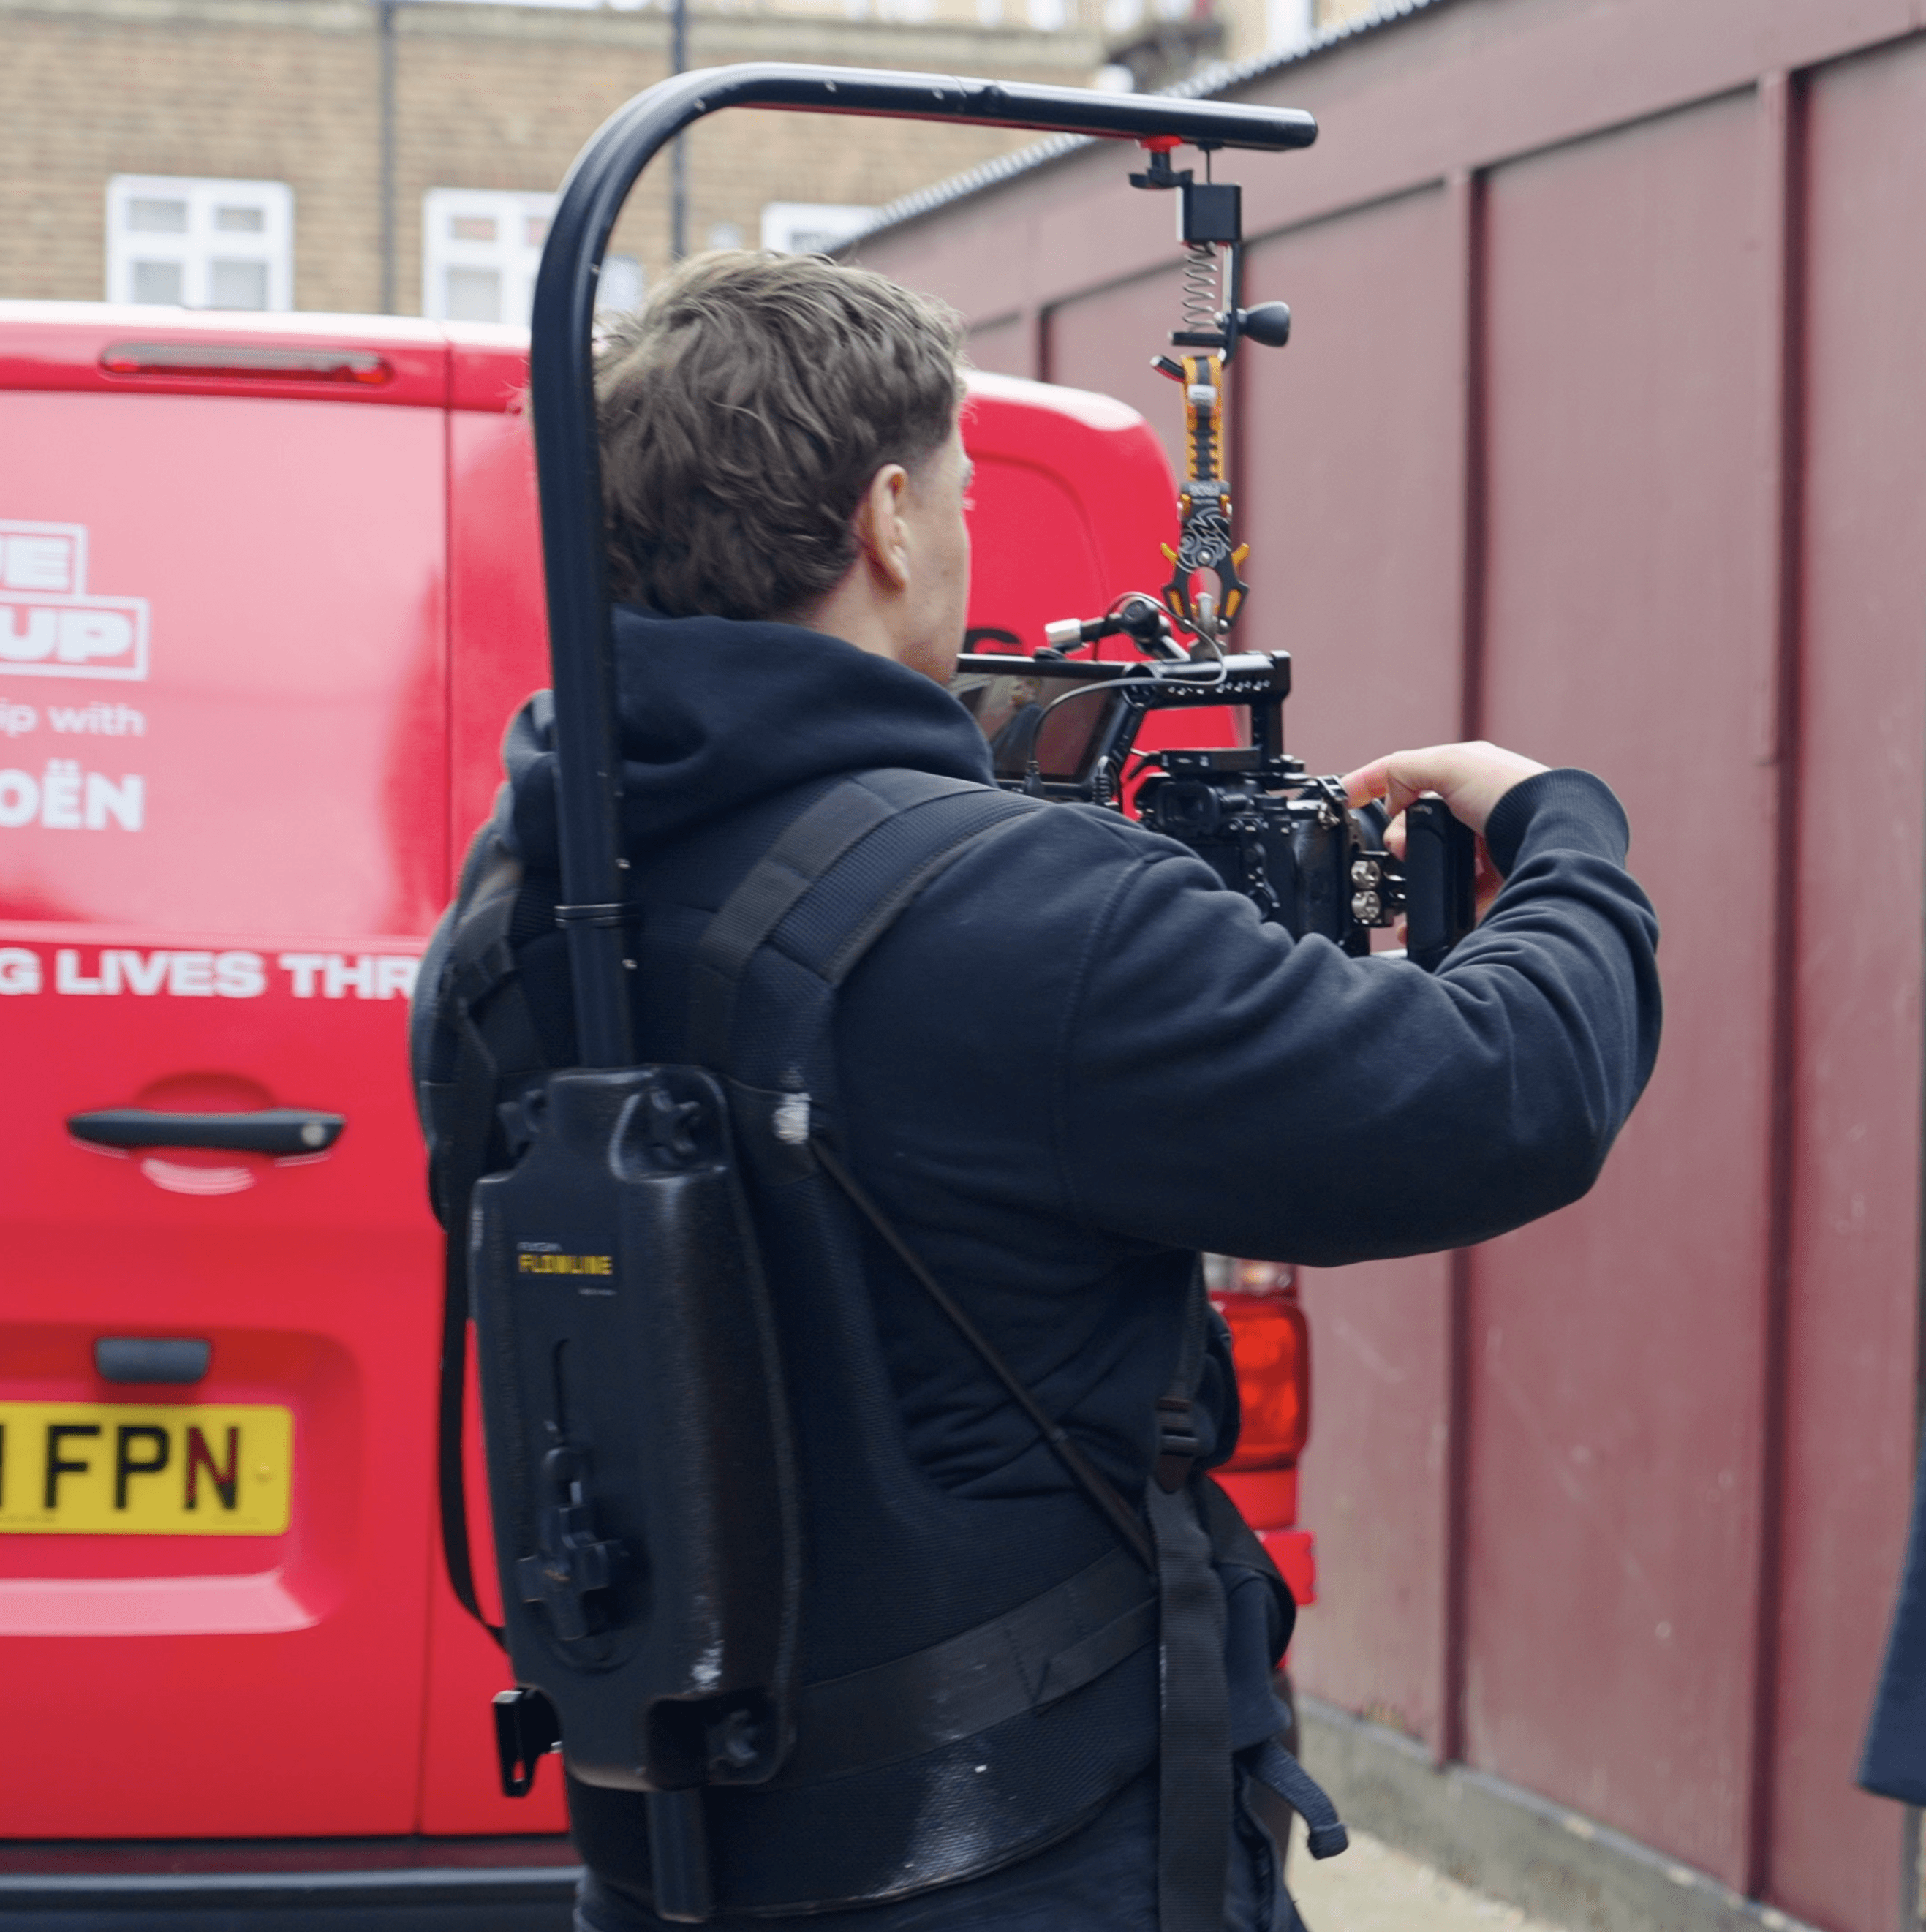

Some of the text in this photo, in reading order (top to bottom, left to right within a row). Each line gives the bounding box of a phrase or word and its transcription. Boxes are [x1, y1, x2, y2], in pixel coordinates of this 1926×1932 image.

[0, 608, 132, 662] UP
[48, 703, 145, 736] with
[0, 759, 145, 831] OËN
[56, 950, 266, 997] LIVES
[44, 1423, 239, 1511] FPN
